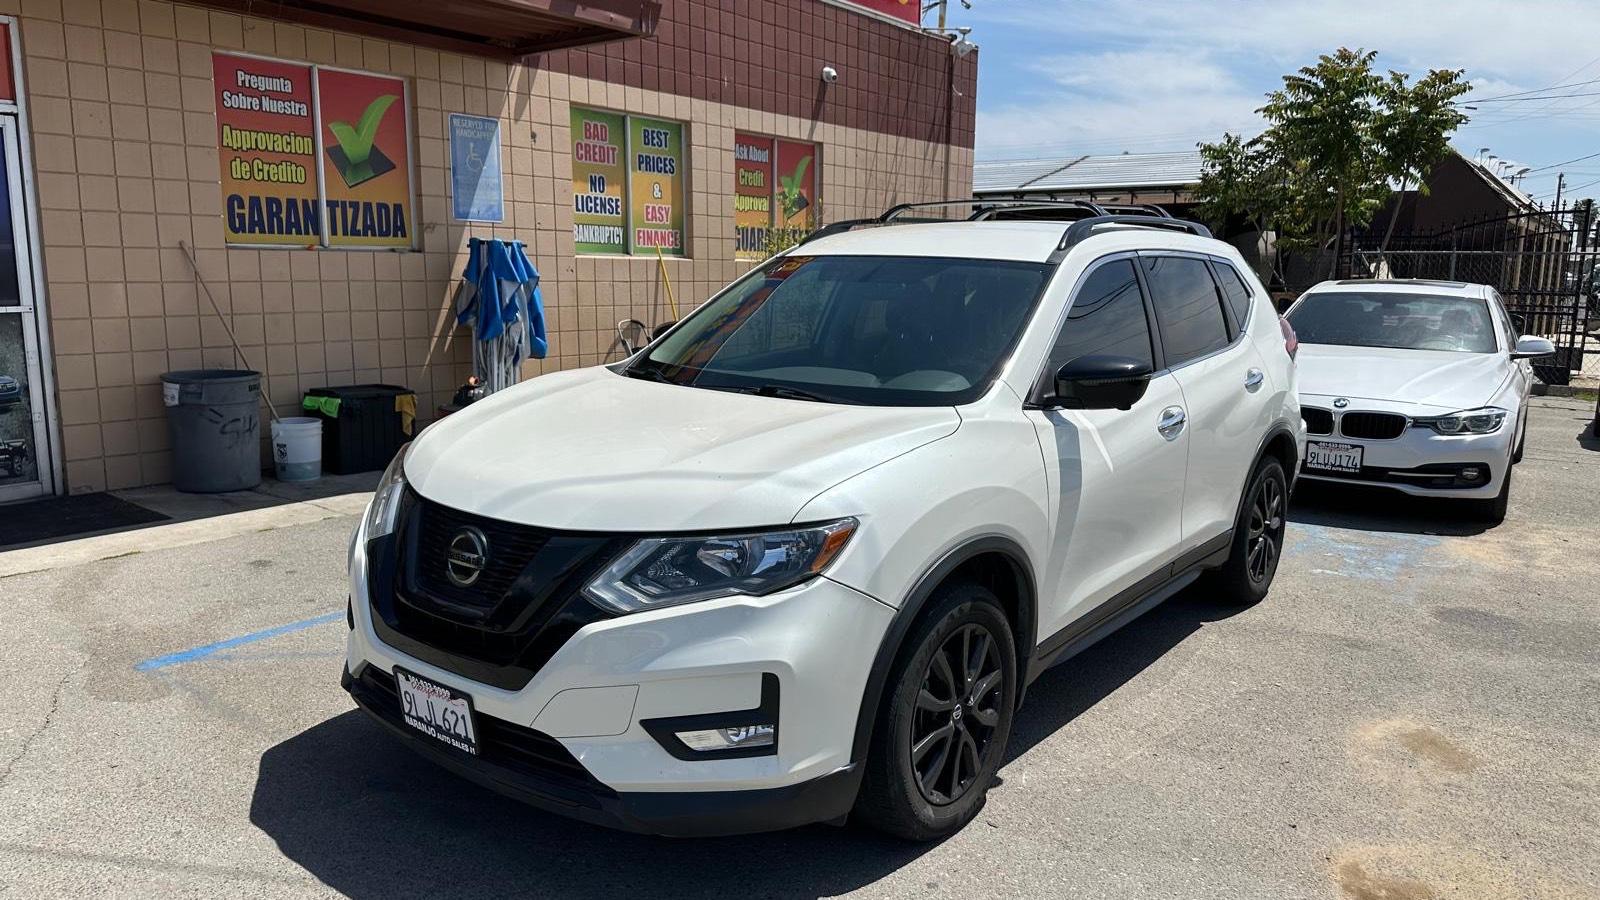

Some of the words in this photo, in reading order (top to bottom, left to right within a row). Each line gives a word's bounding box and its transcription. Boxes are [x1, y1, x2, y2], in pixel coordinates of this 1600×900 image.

[236, 69, 293, 94] Pregunta
[222, 90, 260, 111] Sobre
[261, 95, 308, 117] Nuestra
[222, 124, 314, 155] Approvacion
[583, 121, 608, 142] BAD
[642, 127, 670, 149] BEST
[575, 142, 617, 165] CREDIT
[637, 152, 676, 175] PRICES
[735, 143, 748, 160] Ask
[749, 146, 769, 163] About
[231, 156, 251, 180] de
[252, 158, 306, 184] Credito
[739, 167, 764, 187] Credit
[588, 174, 606, 194] NO
[652, 182, 663, 199] &
[574, 194, 621, 216] LICENSE
[735, 193, 769, 212] Approval
[226, 193, 407, 238] GARANTIZADA
[644, 204, 671, 224] EASY
[574, 223, 624, 244] BANKRUPTCY
[636, 228, 680, 248] FINANCE
[1309, 451, 1358, 469] 9LUJ174
[403, 690, 469, 739] 9LJL621
[404, 714, 437, 738] NARANJO
[437, 732, 451, 744] AUTO
[452, 738, 470, 753] SALES
